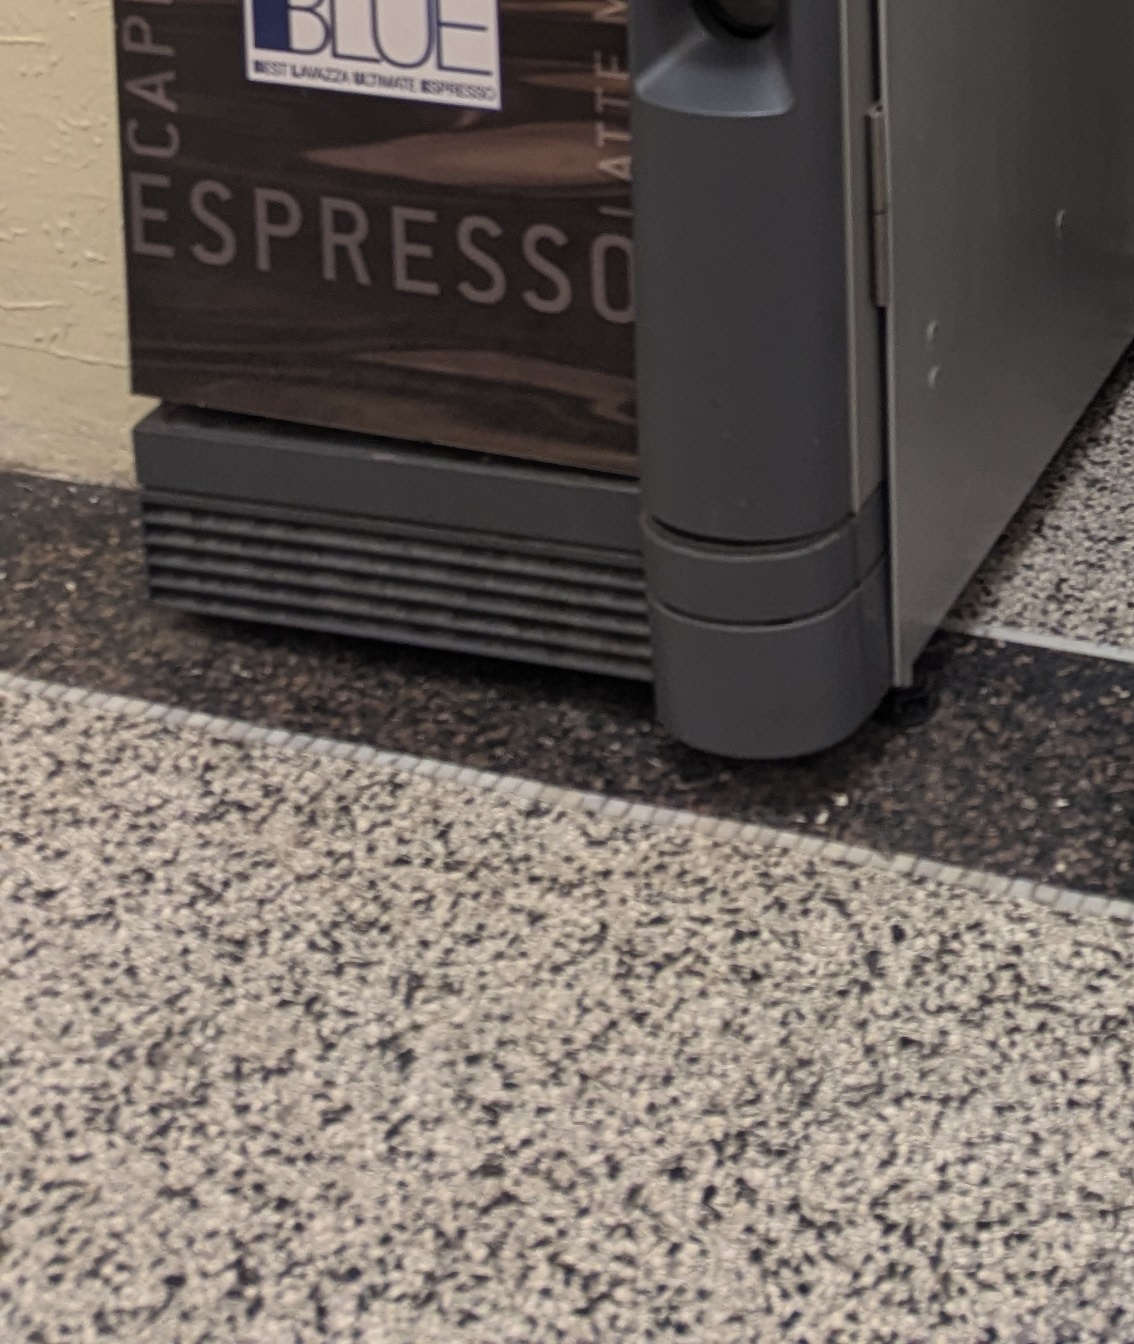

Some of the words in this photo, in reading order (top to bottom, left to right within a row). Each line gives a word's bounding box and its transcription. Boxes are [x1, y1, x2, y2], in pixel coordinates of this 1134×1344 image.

[254, 60, 288, 75] BEST
[291, 65, 350, 84] LAVAZZA
[352, 72, 416, 94] ULTIMATE
[421, 79, 497, 103] ESPRESSO
[129, 171, 636, 323] ESPRESSO
